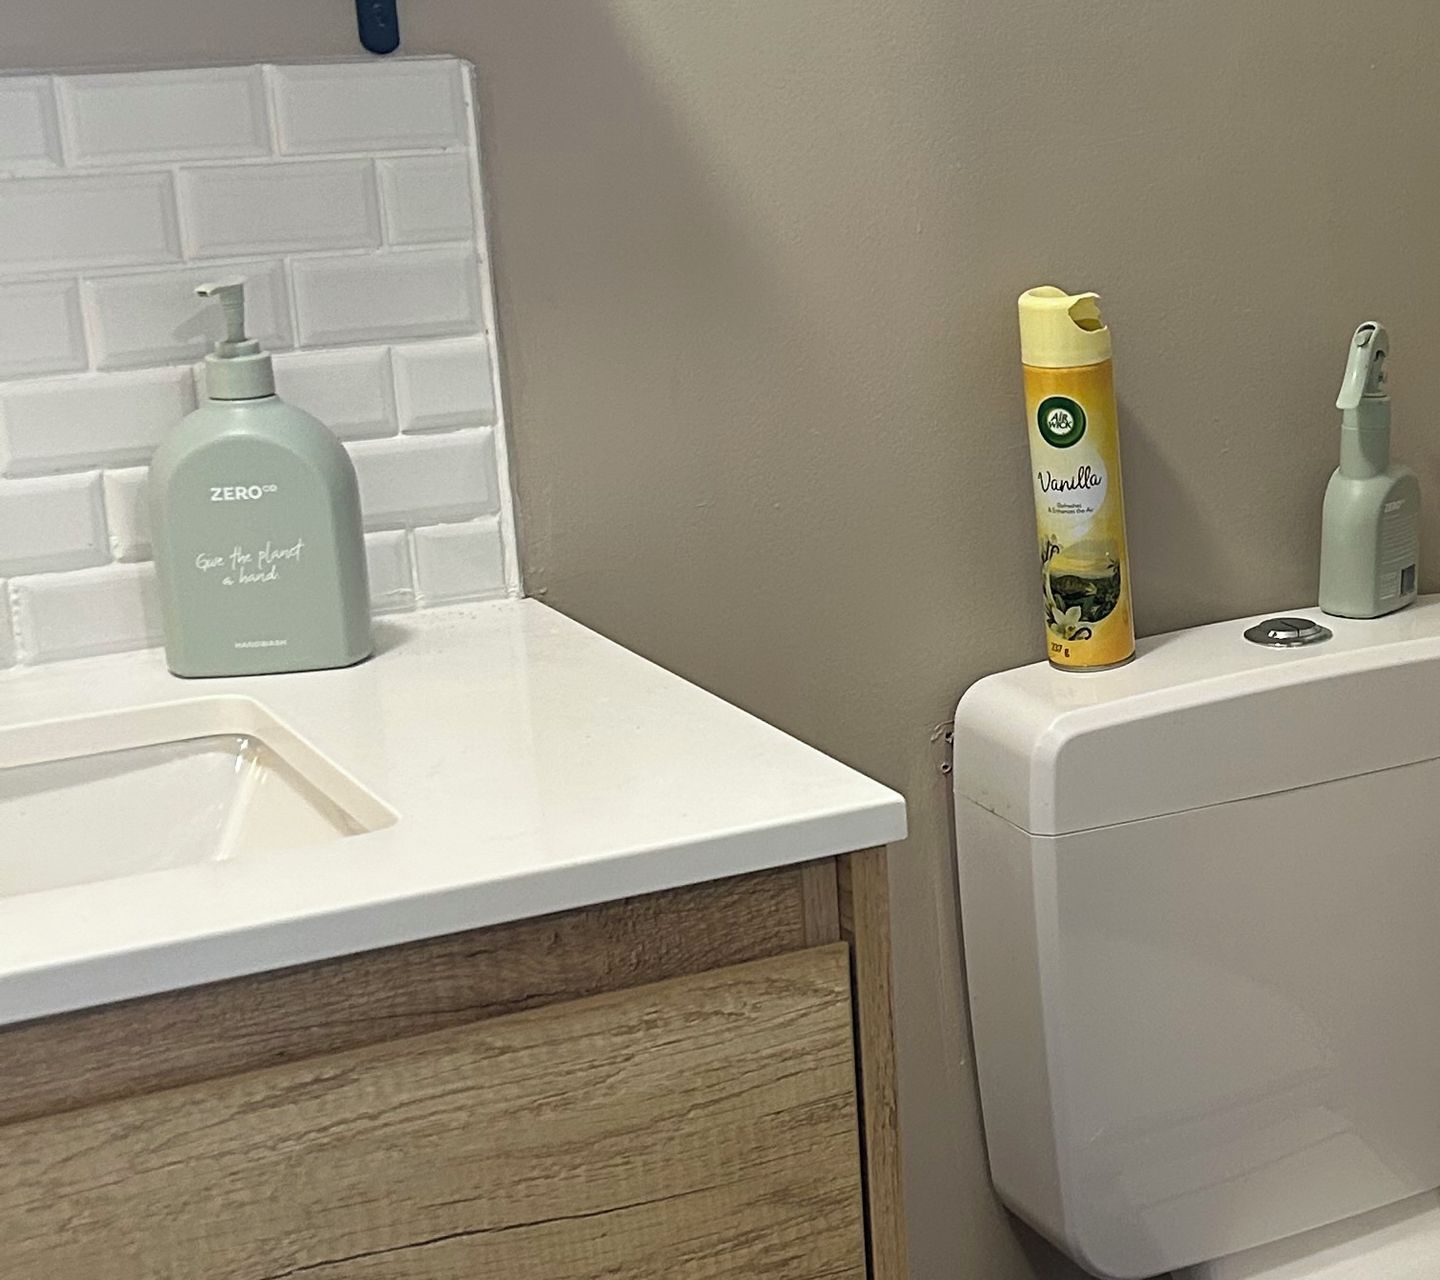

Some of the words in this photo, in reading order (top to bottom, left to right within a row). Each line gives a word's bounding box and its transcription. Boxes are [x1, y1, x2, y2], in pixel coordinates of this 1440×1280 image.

[1038, 466, 1102, 493] Vanilla
[195, 552, 225, 572] Give
[229, 545, 252, 571] the
[258, 537, 305, 571] planet
[222, 576, 235, 586] a
